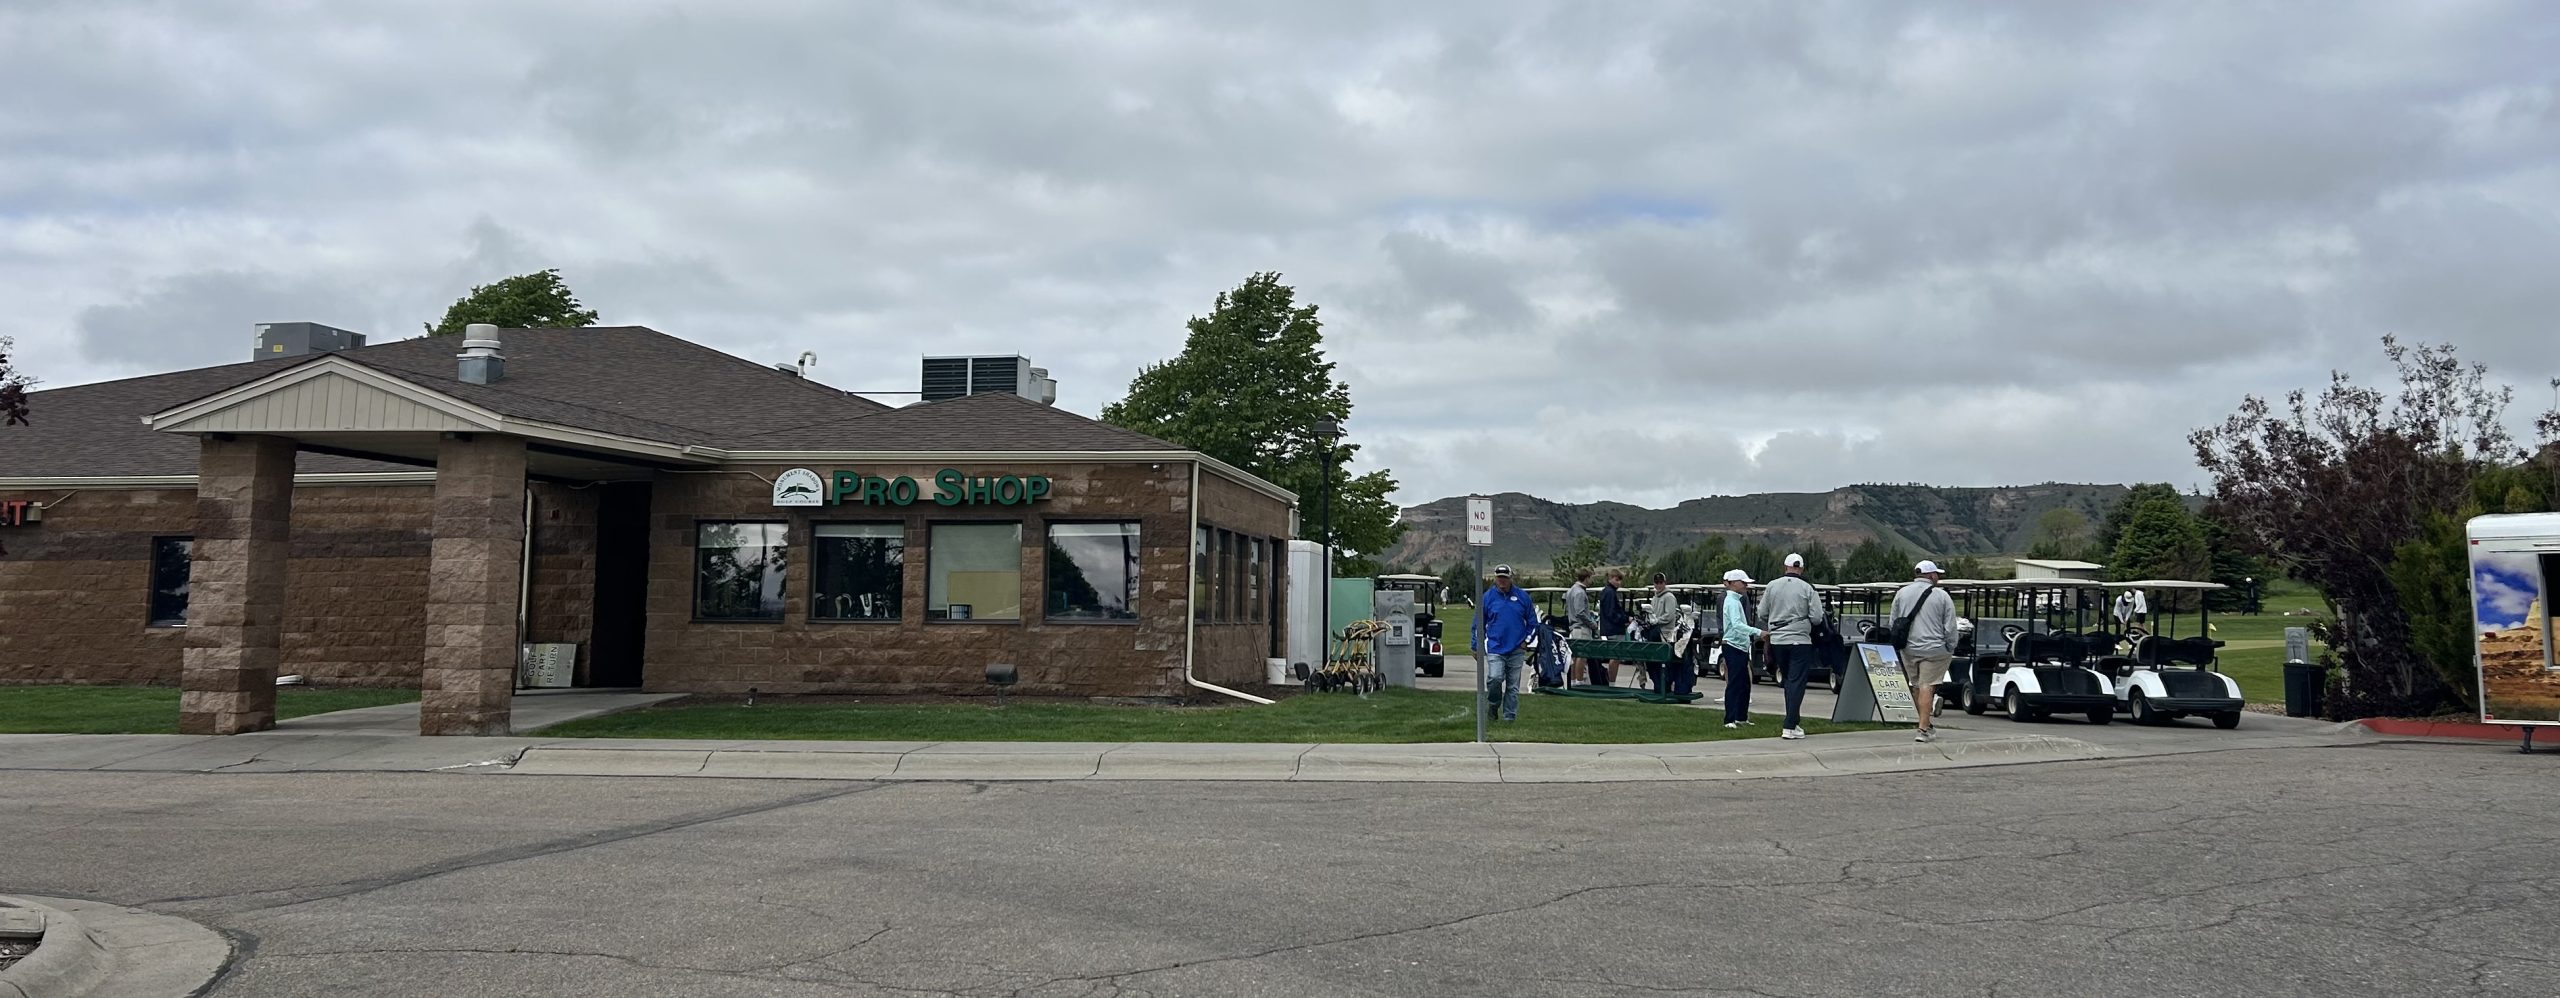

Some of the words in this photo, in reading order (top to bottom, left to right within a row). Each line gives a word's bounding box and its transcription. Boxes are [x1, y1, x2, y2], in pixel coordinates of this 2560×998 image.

[1474, 511, 1486, 520] NO
[1469, 524, 1490, 532] PARKING
[538, 653, 546, 677] CART
[547, 646, 558, 684] RETURN
[1874, 667, 1896, 676] GOLF
[1879, 680, 1900, 688] CART
[1878, 691, 1911, 701] RETURN
